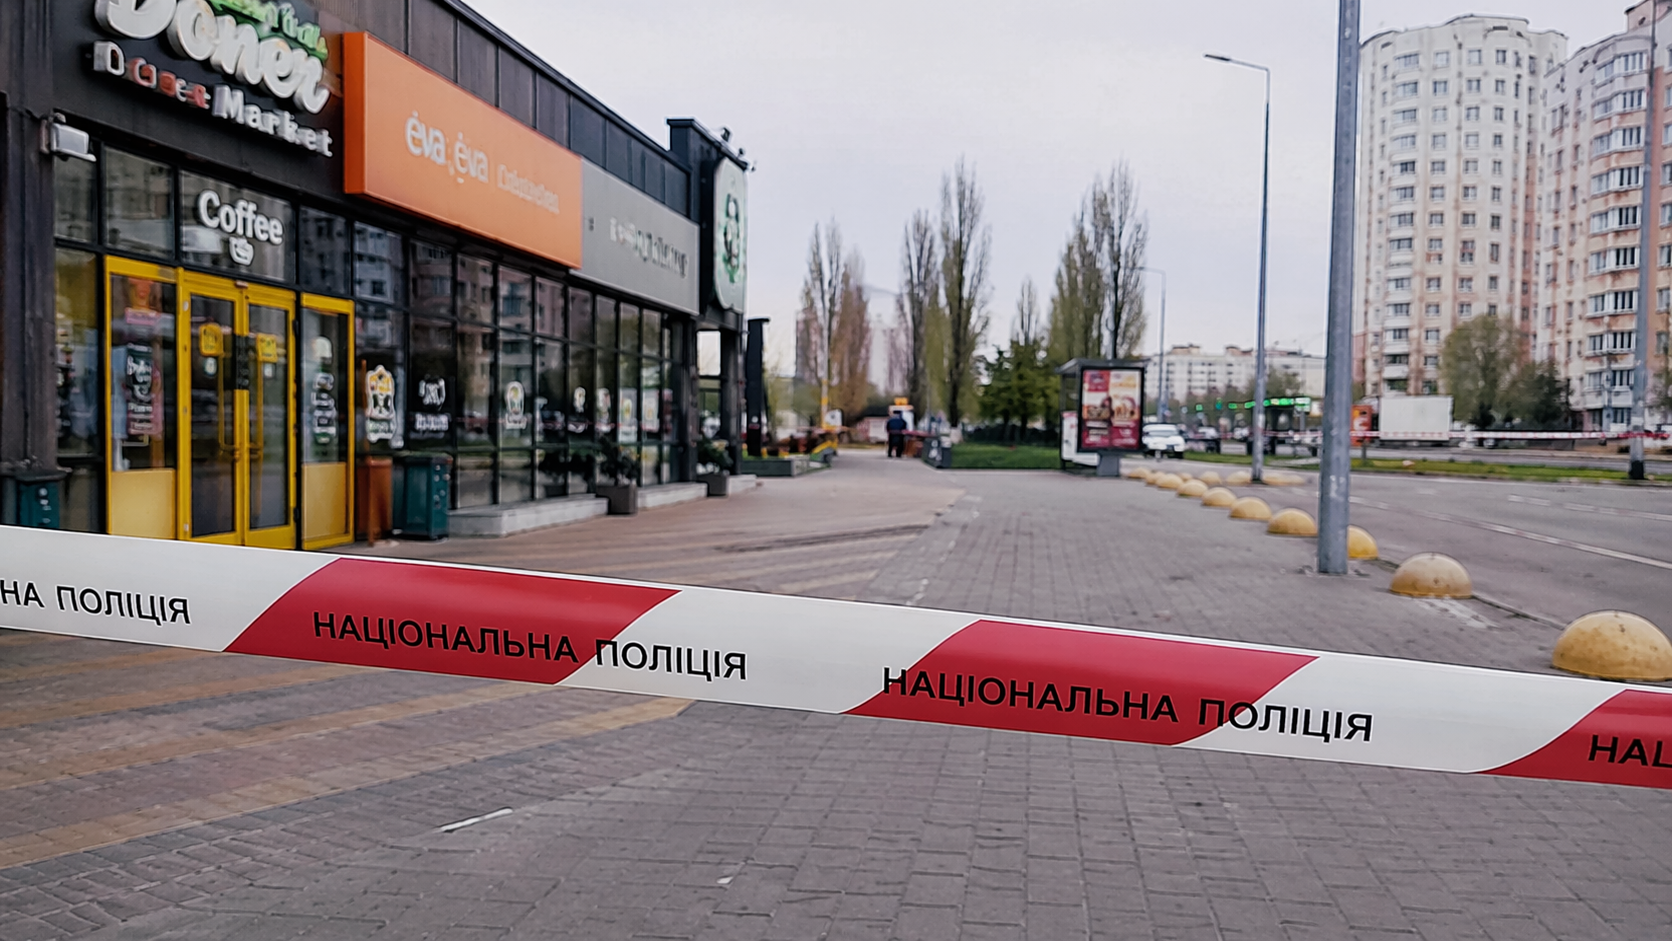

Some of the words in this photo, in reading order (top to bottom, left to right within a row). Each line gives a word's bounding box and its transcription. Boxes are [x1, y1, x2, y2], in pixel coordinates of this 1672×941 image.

[200, 190, 283, 245] Coffee
[56, 585, 191, 626] ПОЛІЦІЯ
[313, 611, 579, 664] НАЦІОНАЛЬНА
[595, 639, 747, 682] ПОЛІЦІЯ
[883, 667, 1179, 723] НАЦІОНАЛЬНА
[1198, 698, 1373, 743] ПОЛІЦІЯ
